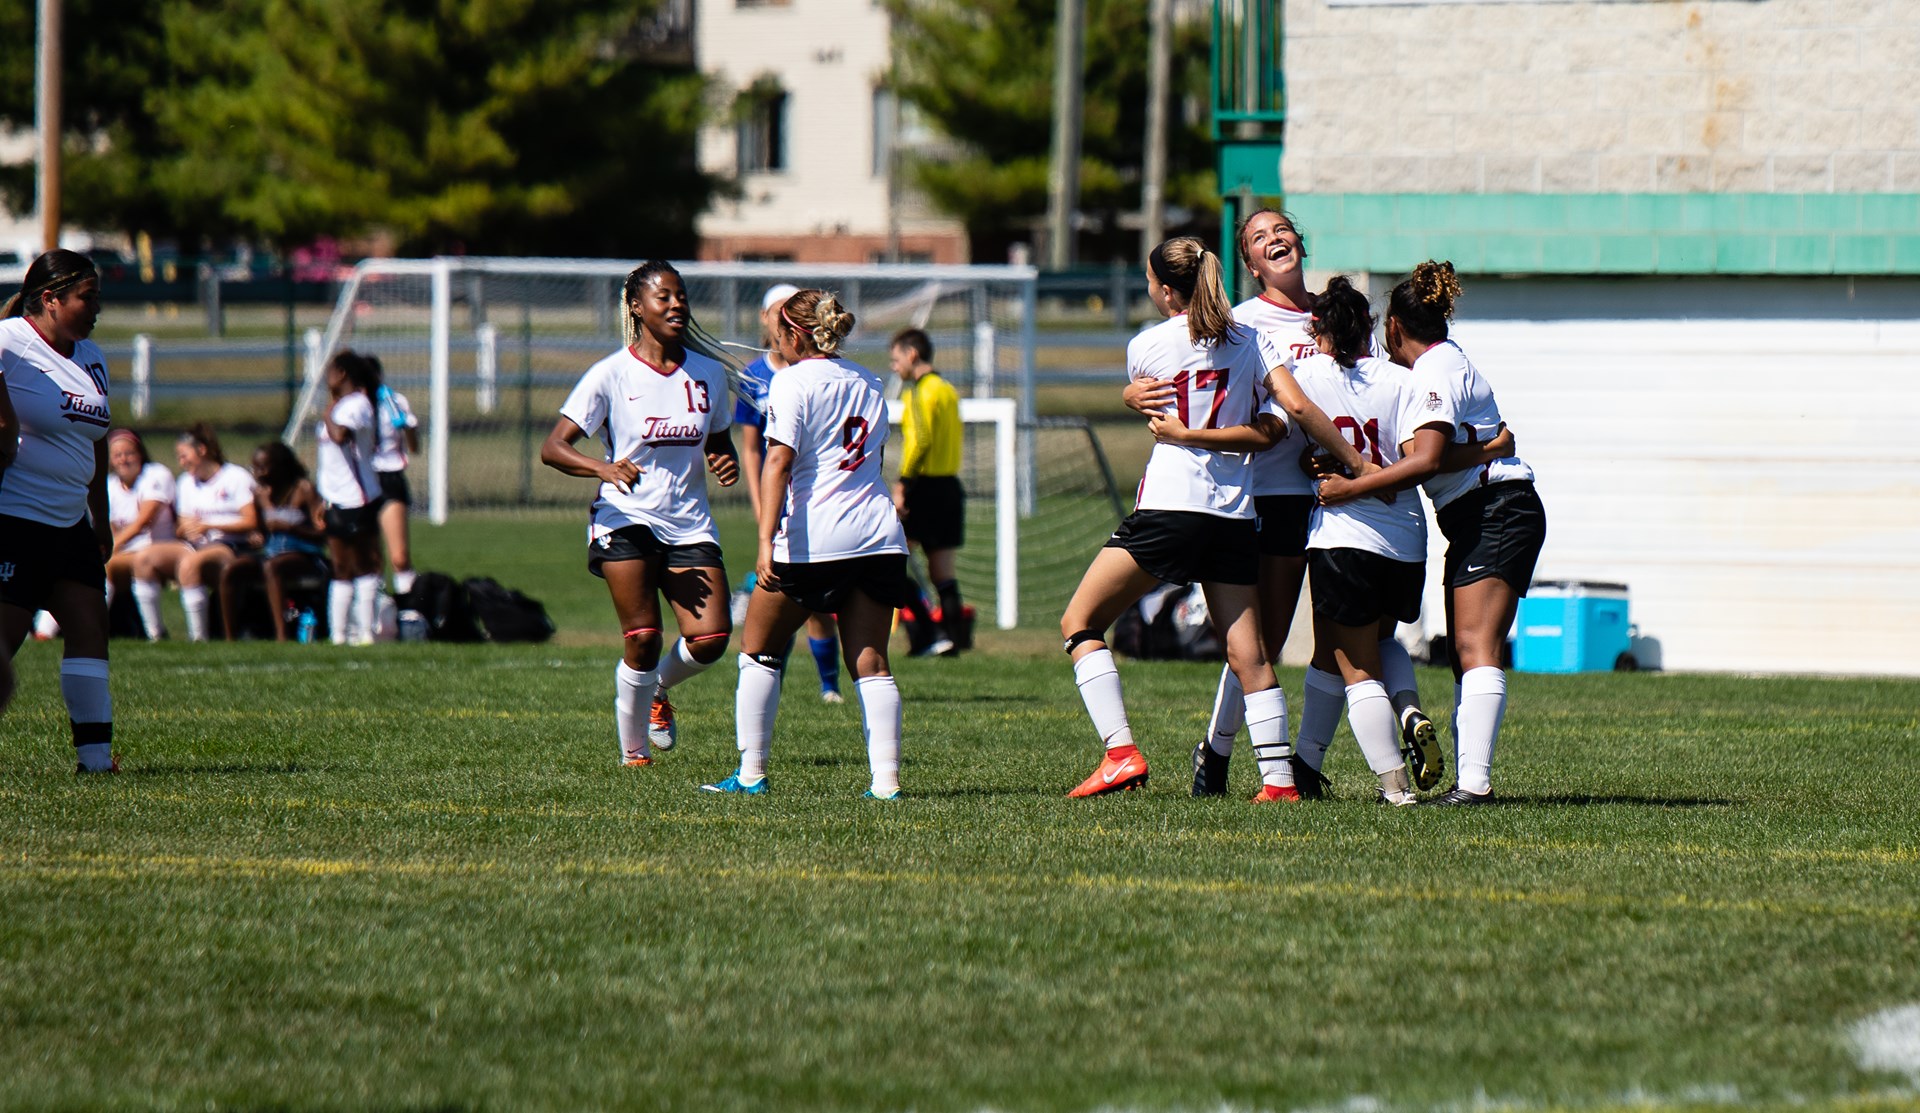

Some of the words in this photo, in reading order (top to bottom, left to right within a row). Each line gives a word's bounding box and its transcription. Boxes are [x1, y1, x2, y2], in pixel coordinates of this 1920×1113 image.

[85, 362, 108, 396] 10
[60, 390, 111, 419] Titans
[684, 380, 711, 413] 13
[1173, 367, 1230, 430] 17
[642, 416, 704, 440] Titans
[838, 415, 869, 473] 9
